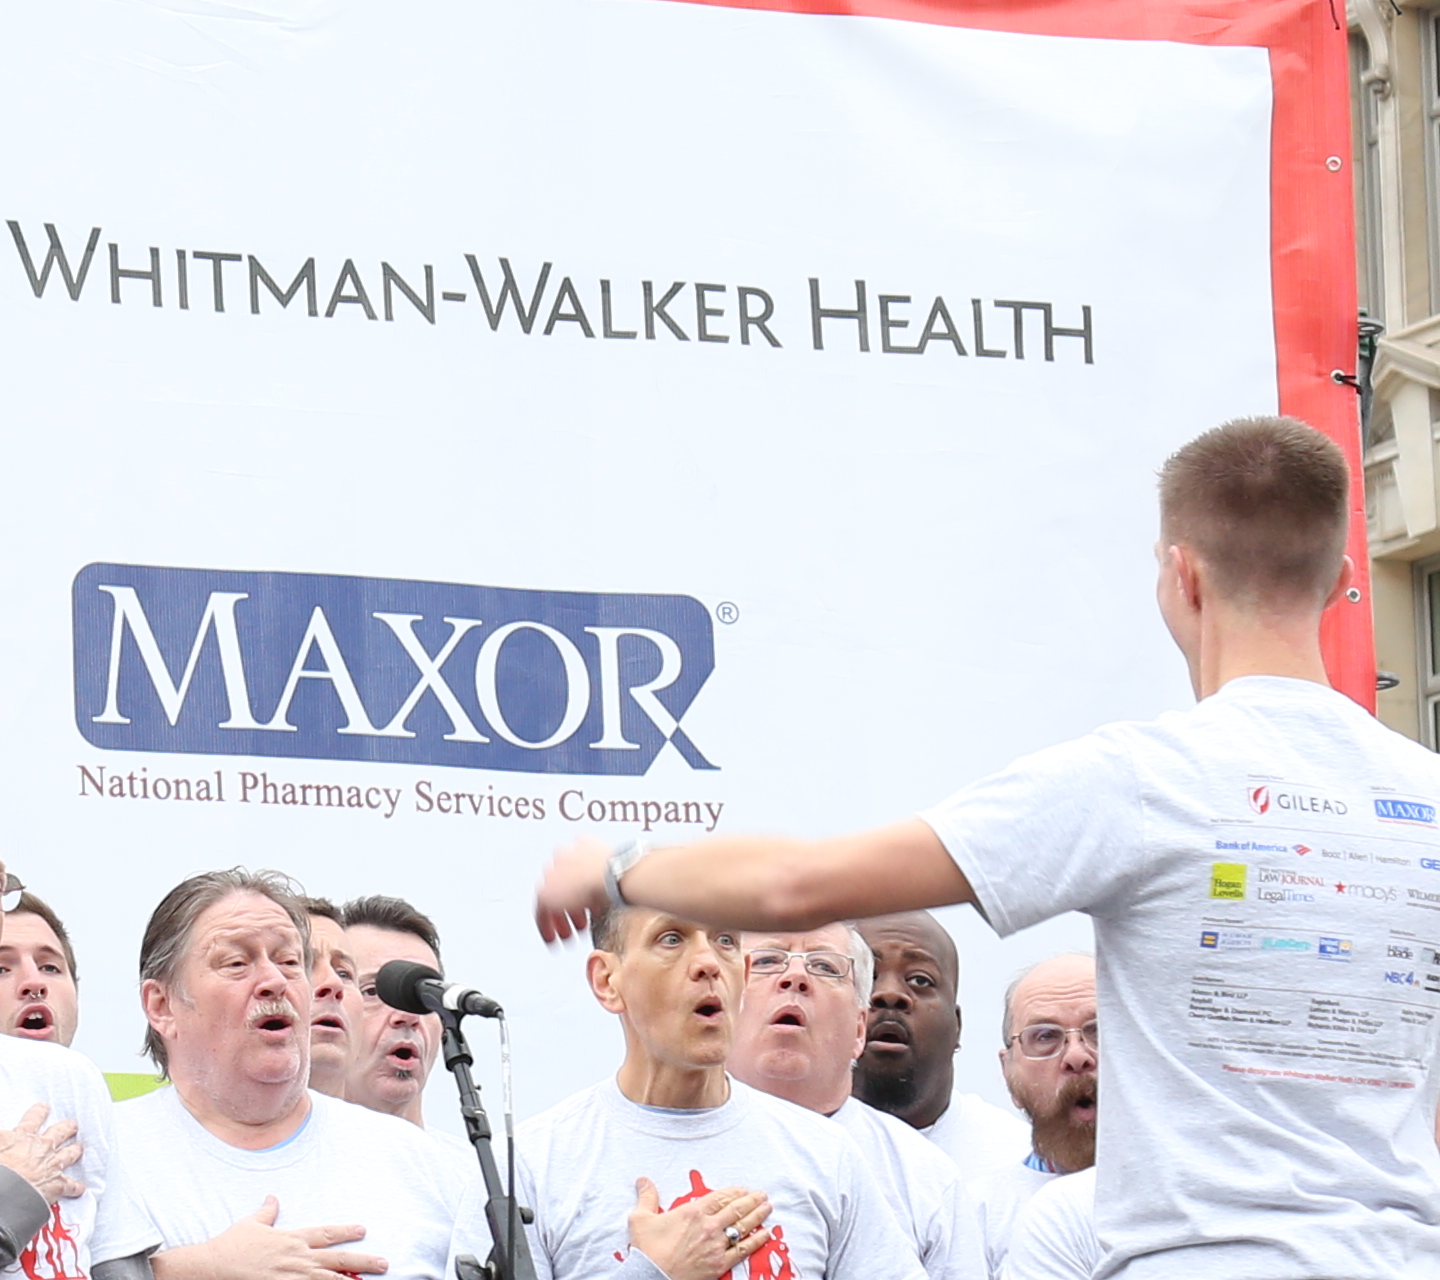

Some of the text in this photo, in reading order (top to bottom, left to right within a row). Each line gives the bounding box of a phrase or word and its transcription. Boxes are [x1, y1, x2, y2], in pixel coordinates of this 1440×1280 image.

[7, 220, 1094, 365] WHITMAN-WALKER HEALTH
[92, 584, 722, 771] MAXOR
[76, 765, 724, 833] National Pharmacy Services Company
[1277, 794, 1348, 816] GILEAD
[1376, 801, 1437, 823] MAXOR
[1215, 840, 1288, 853] Bank of America
